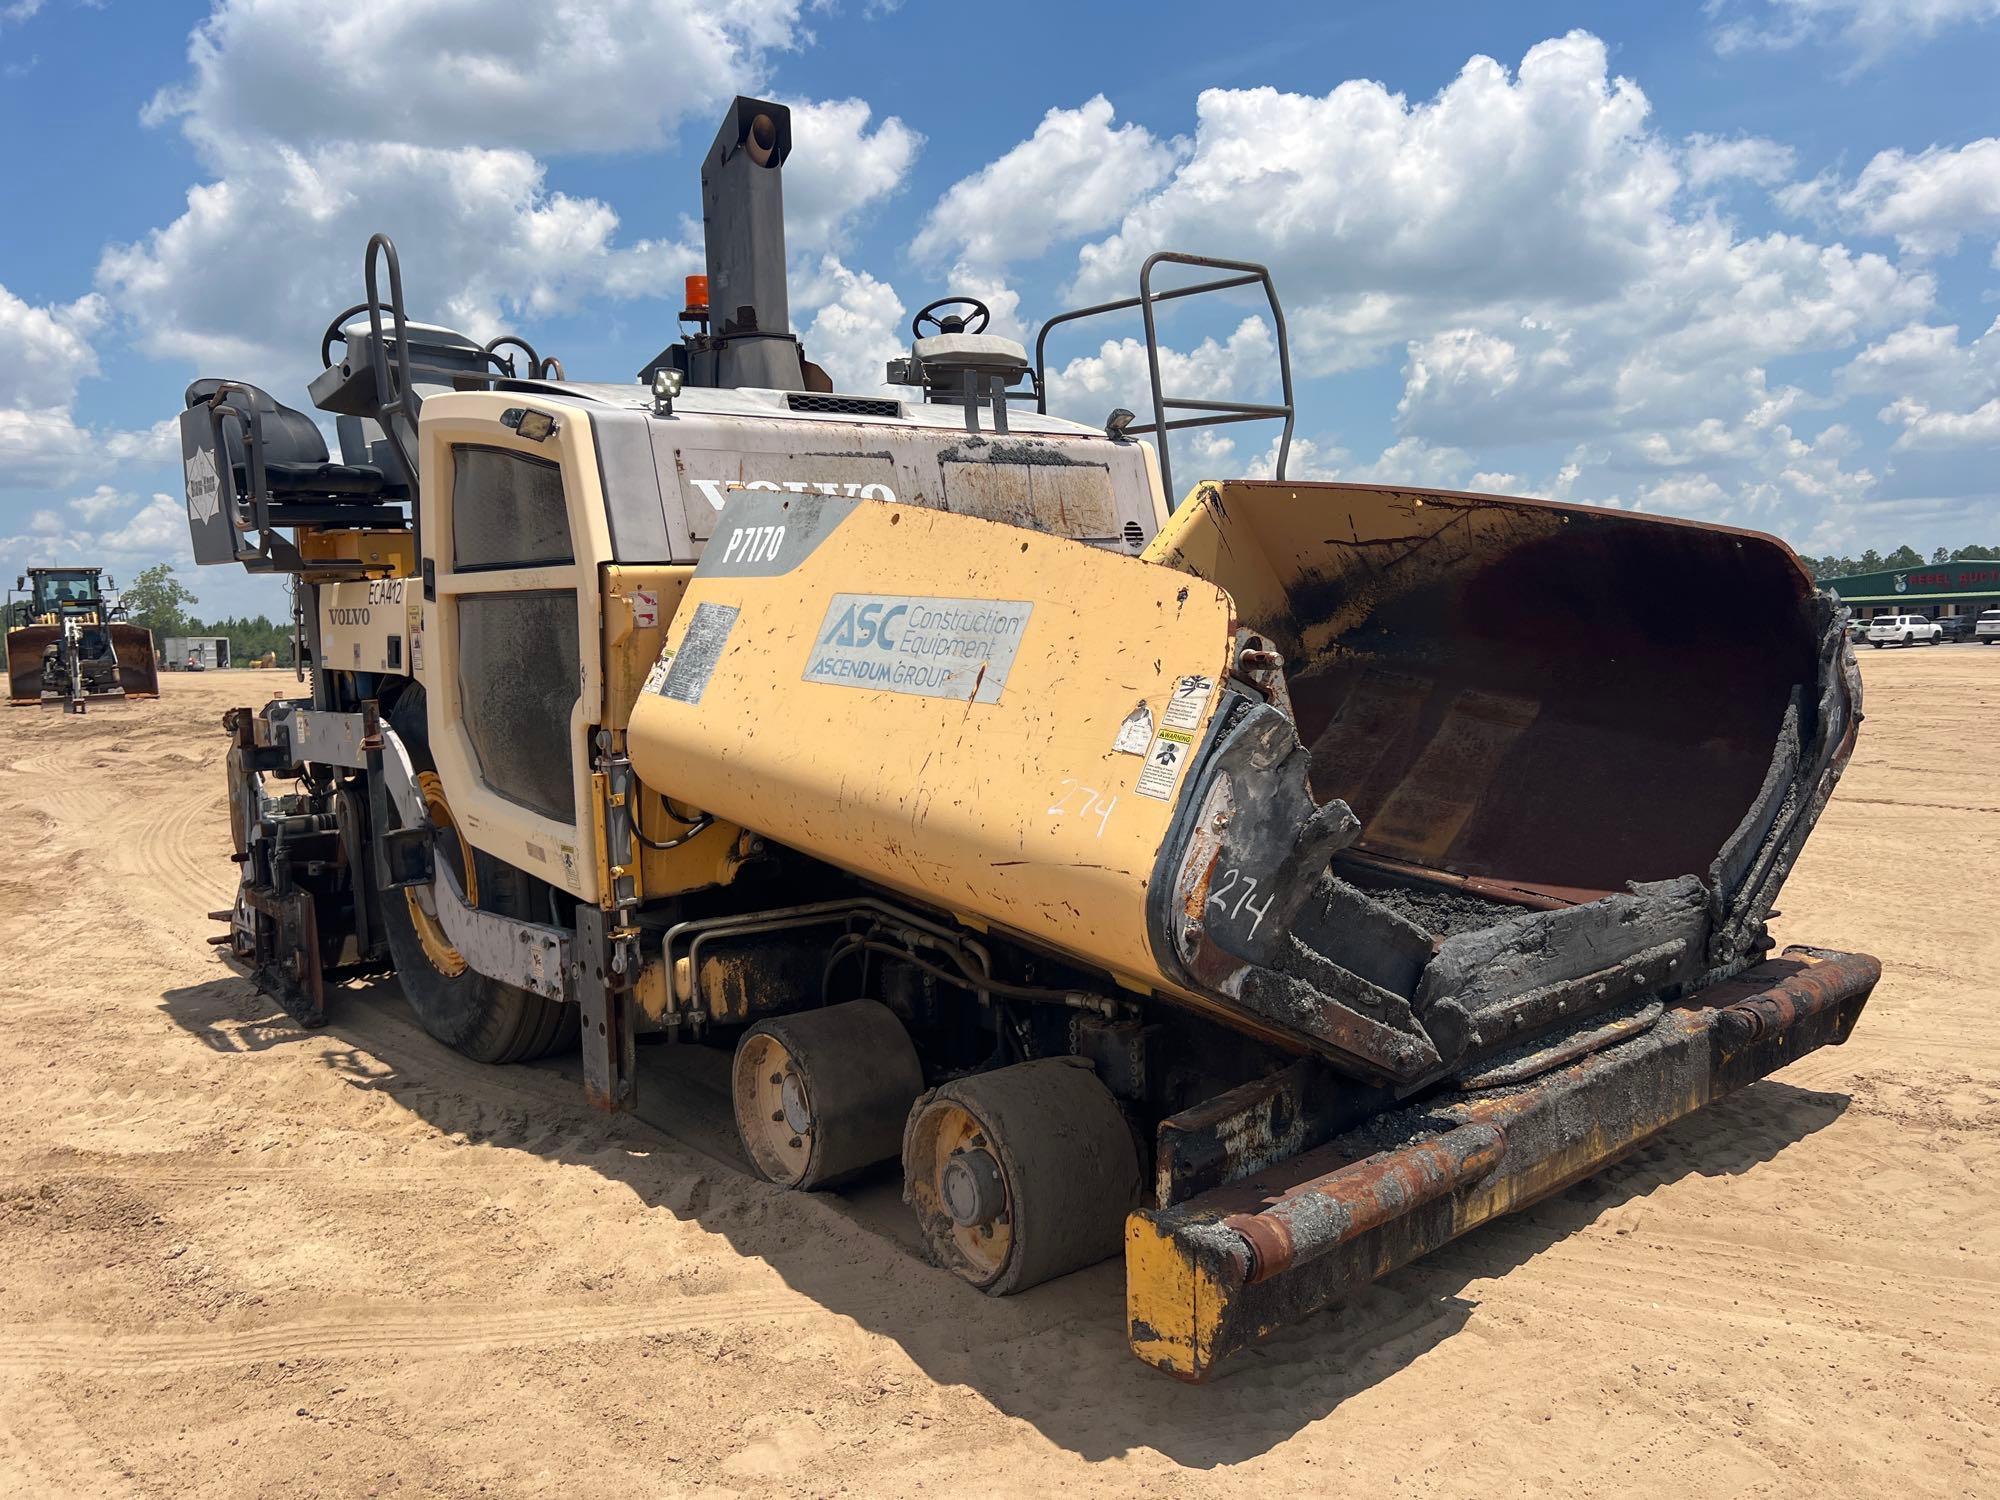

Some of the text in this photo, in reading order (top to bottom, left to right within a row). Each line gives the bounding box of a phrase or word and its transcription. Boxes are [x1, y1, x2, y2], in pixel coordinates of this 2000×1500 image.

[722, 525, 786, 563] P7170
[368, 581, 402, 605] ECA412
[328, 607, 371, 626] VOLVO
[822, 603, 908, 650] ASC
[908, 605, 1020, 635] Construction
[899, 630, 997, 660] Equipment
[811, 657, 891, 683] ASCENDUM
[1164, 731, 1191, 743] WARNING
[1047, 778, 1118, 840] 274
[1209, 868, 1275, 942] 274
